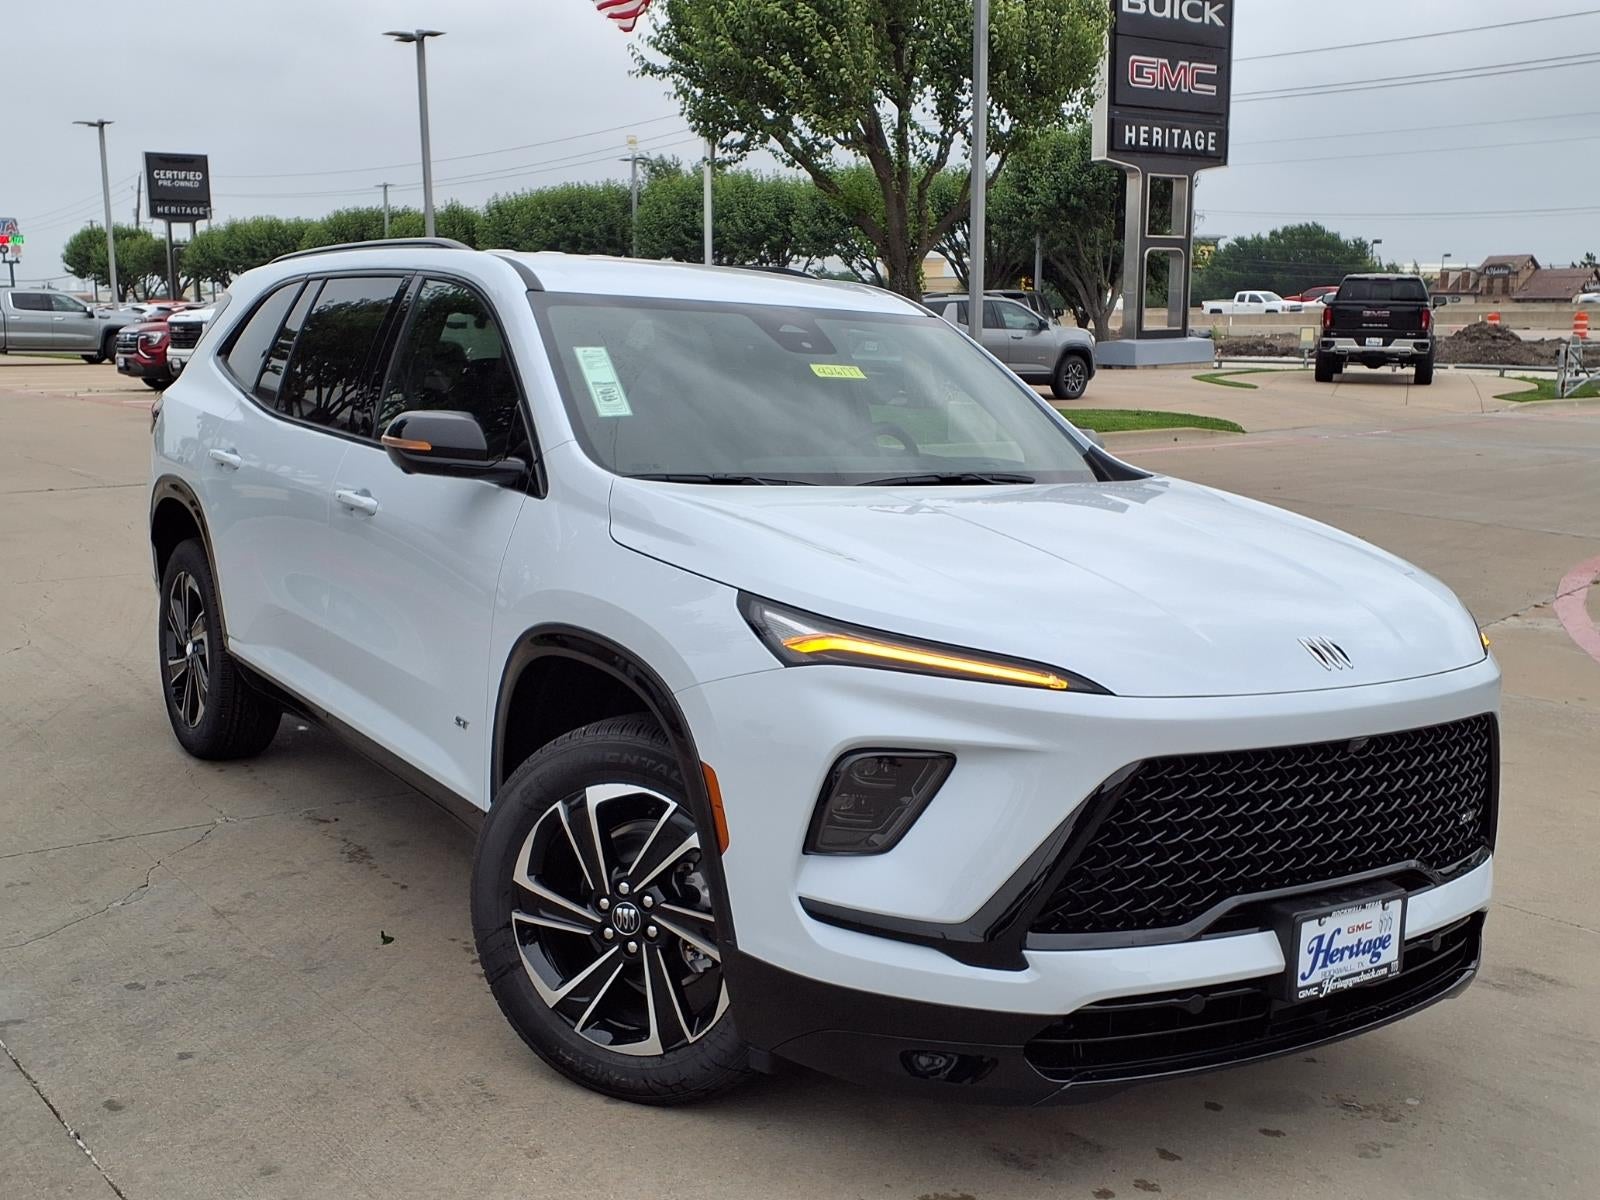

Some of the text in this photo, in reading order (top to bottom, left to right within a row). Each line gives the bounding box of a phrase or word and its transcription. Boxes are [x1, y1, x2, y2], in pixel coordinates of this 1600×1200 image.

[1122, 0, 1225, 26] BUICK
[1128, 55, 1217, 96] GMC
[1125, 125, 1216, 151] HERITAGE
[153, 169, 203, 180] CERTIFIED
[158, 179, 199, 188] PRE-OWNED
[157, 206, 205, 215] HERITAGE
[1347, 921, 1373, 934] GMC
[1301, 929, 1391, 981] Heritage
[1298, 987, 1319, 999] GMC
